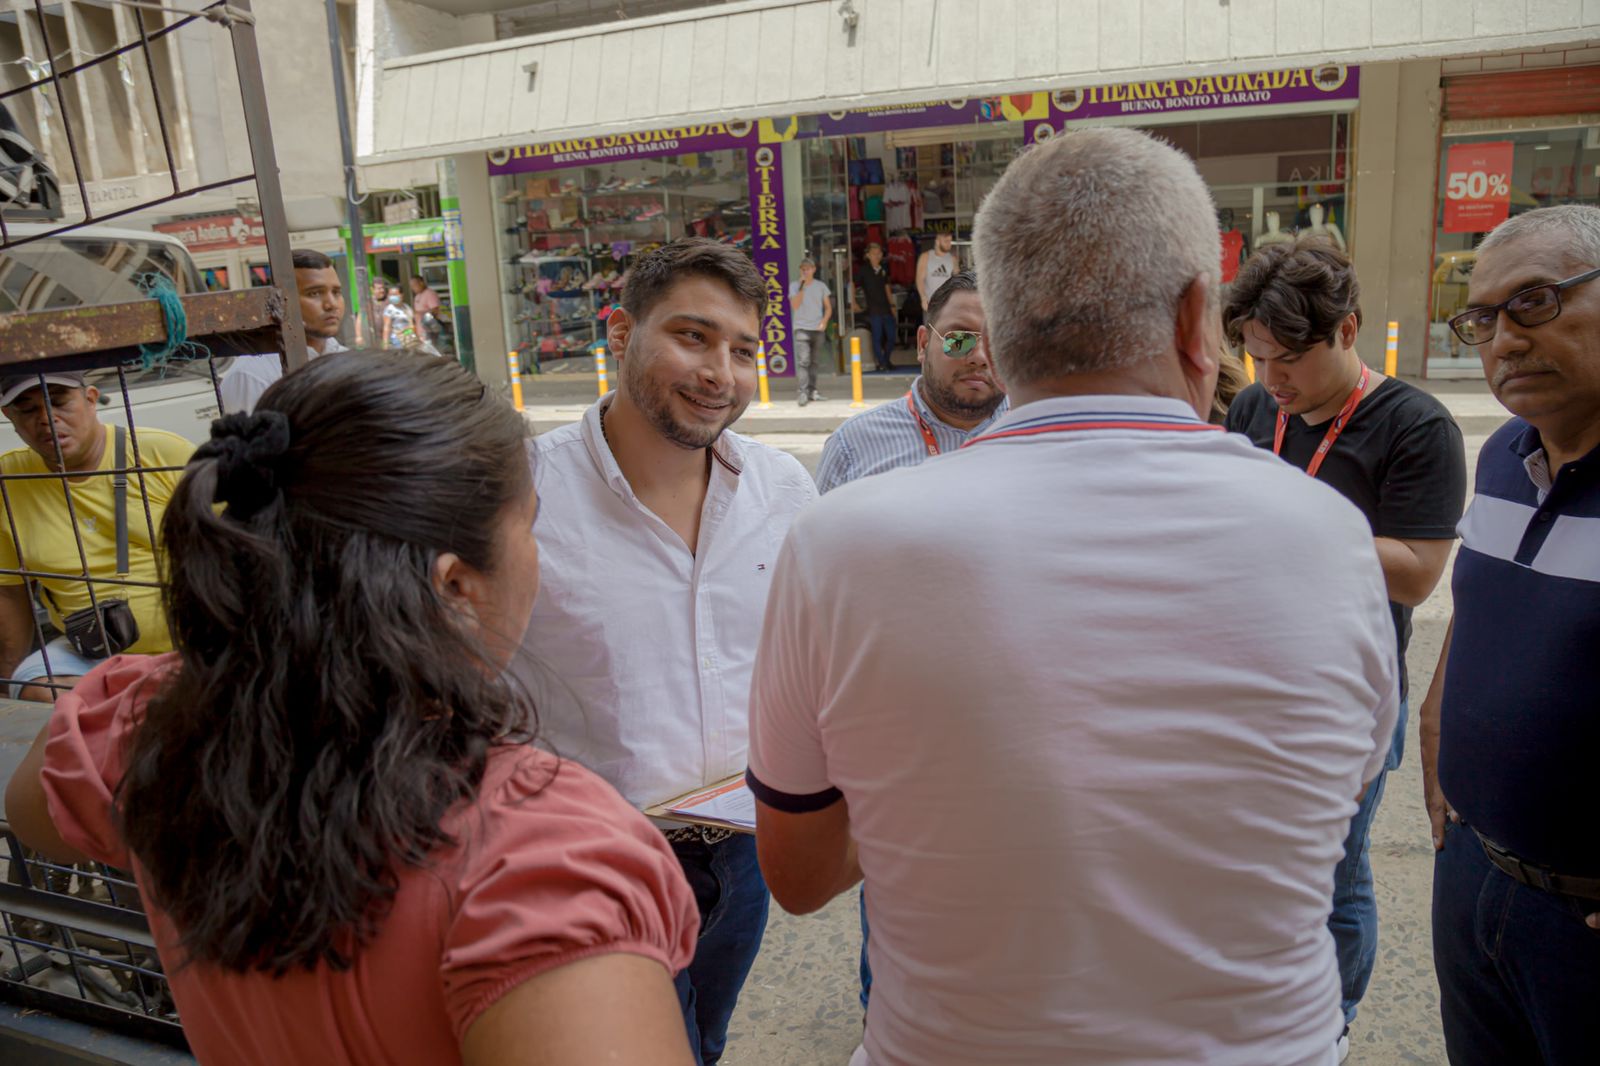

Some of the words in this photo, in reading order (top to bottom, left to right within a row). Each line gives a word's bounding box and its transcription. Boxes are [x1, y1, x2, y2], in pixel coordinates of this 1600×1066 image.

[1121, 99, 1163, 113] BUENO,
[1165, 96, 1210, 109] BONITO
[1212, 94, 1220, 105] Y
[1222, 91, 1271, 105] BARATO
[553, 150, 589, 163] BUENO,
[590, 147, 627, 160] BONITO
[629, 144, 637, 154] Y
[638, 140, 679, 154] BARATO
[1447, 171, 1508, 200] 50%
[755, 166, 781, 249] TIERRA
[763, 262, 785, 356] SAGRADA
